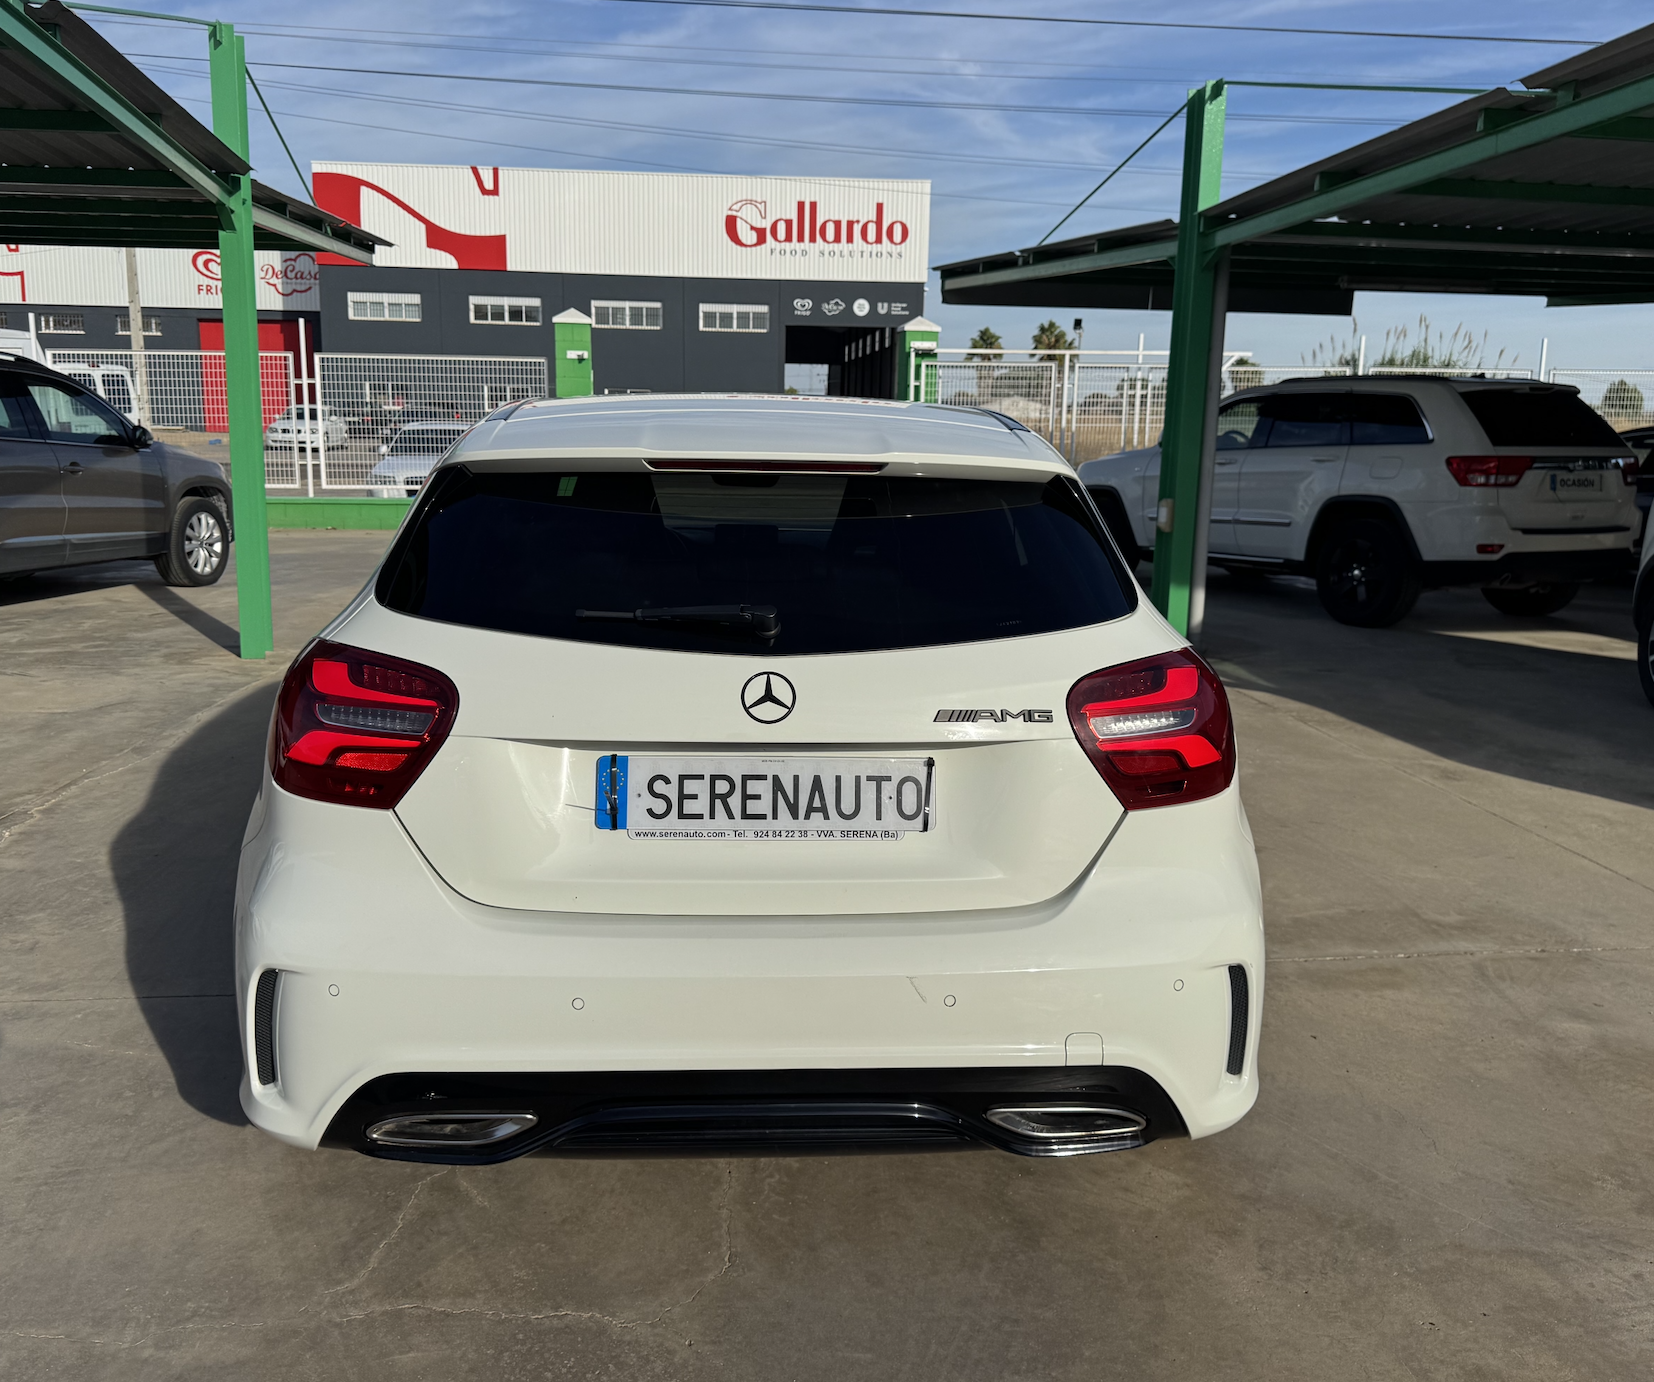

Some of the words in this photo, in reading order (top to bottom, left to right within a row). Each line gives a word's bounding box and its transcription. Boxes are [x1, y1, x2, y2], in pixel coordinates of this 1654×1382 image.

[725, 198, 909, 248] Gallardo
[770, 248, 808, 257] FOOD
[818, 249, 903, 259] SOLUTIONS
[197, 284, 222, 296] FRI
[1559, 477, 1595, 488] OCASIÓN
[971, 709, 1054, 723] AMG
[645, 774, 923, 821] SERENAUTO
[733, 829, 748, 838] Tel.
[753, 830, 770, 839] 924
[771, 830, 783, 839] 84
[785, 830, 796, 839] 22
[798, 830, 809, 839] 38
[816, 830, 838, 839] VVA.
[840, 830, 879, 839] SERENA
[880, 830, 899, 841] (Ba)
